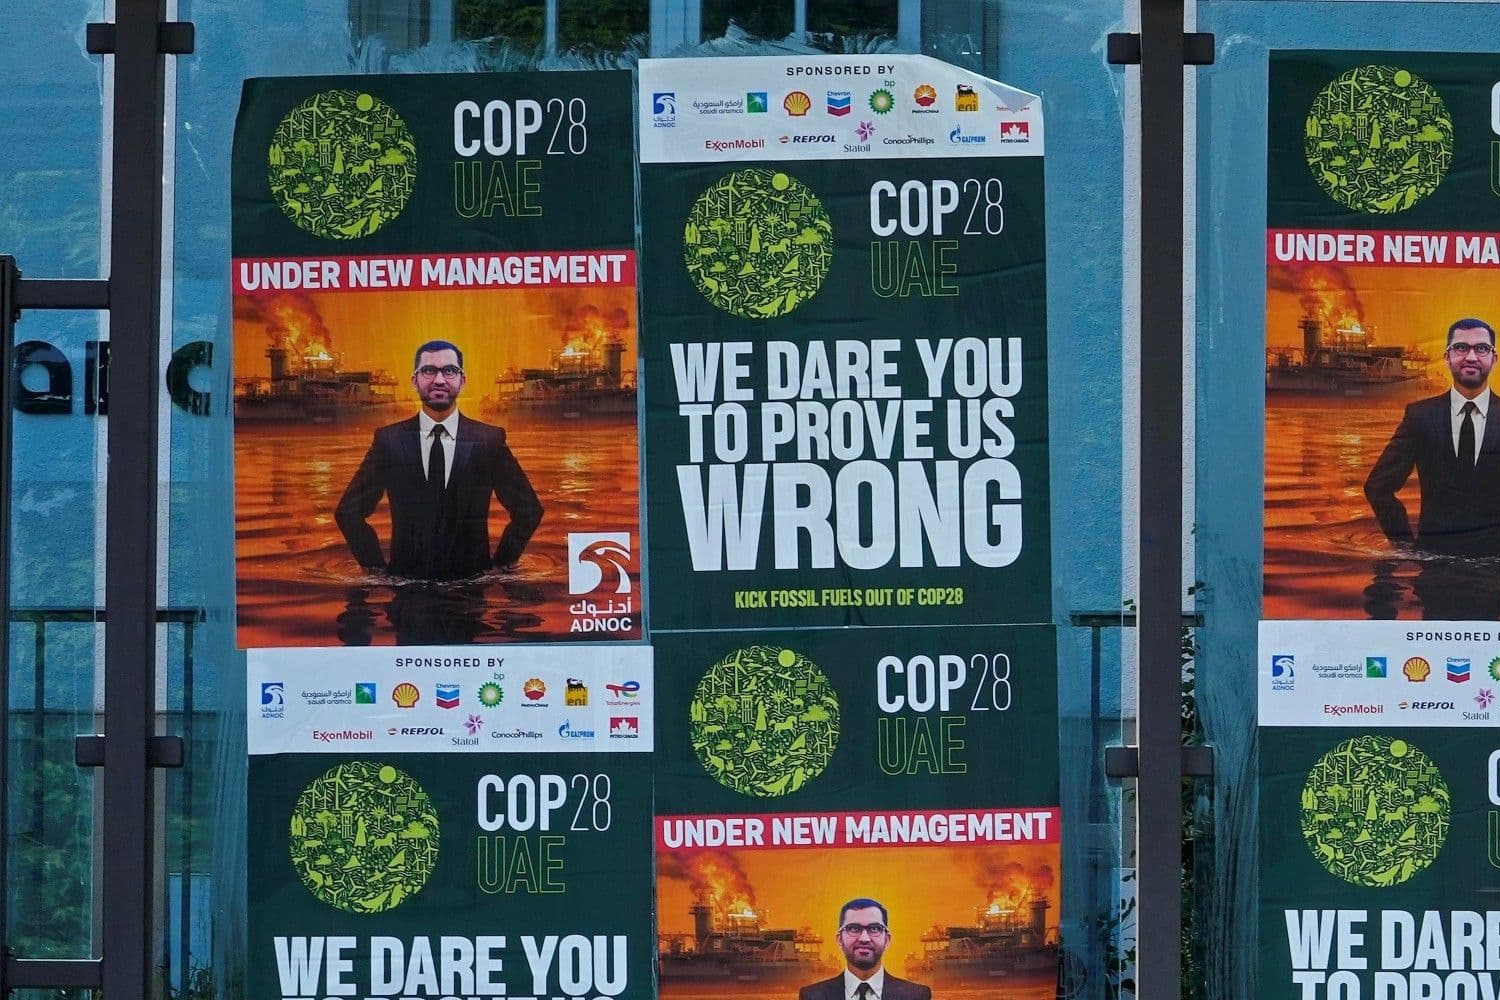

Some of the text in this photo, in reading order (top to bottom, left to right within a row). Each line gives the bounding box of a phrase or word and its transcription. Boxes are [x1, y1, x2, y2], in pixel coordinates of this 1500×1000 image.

[786, 64, 895, 76] SPONSORED BY
[884, 80, 896, 88] bp
[958, 101, 976, 111] eni
[705, 138, 765, 151] ExxonMobil
[792, 134, 836, 143] REPSOL
[883, 136, 935, 146] ConocoPhillips
[844, 143, 871, 152] Statoil
[454, 159, 543, 217] UAE
[1275, 233, 1376, 263] UNDER
[1383, 235, 1447, 264] NEW
[241, 254, 627, 291] UNDER NEW MANAGEMENT
[871, 241, 959, 297] UAE
[669, 337, 1023, 402] WE DARE YOU
[679, 398, 1015, 463] TO PROVE US
[676, 459, 1023, 571] WRONG
[735, 588, 963, 608] KICK FOSSIL FUELS OUT OF COP28
[570, 617, 632, 633] ADNOC
[1406, 632, 1491, 642] SPONSORED
[396, 658, 505, 667] SPONSORED BY
[494, 672, 505, 680] bp
[567, 695, 586, 706] eni
[1412, 701, 1455, 711] REPSOL
[1324, 704, 1384, 717] ExxonMobil
[1463, 710, 1490, 720] Statoil
[312, 730, 373, 743] ExxonMobil
[401, 727, 445, 736] REPSOL
[491, 729, 543, 739] ConocoPhillips
[452, 736, 479, 746] Statoil
[878, 716, 967, 775] UAE
[663, 811, 1053, 849] UNDER NEW MANAGEMENT
[477, 836, 566, 894] UAE
[1285, 910, 1367, 970] WE
[273, 934, 628, 997] WE DARE YOU
